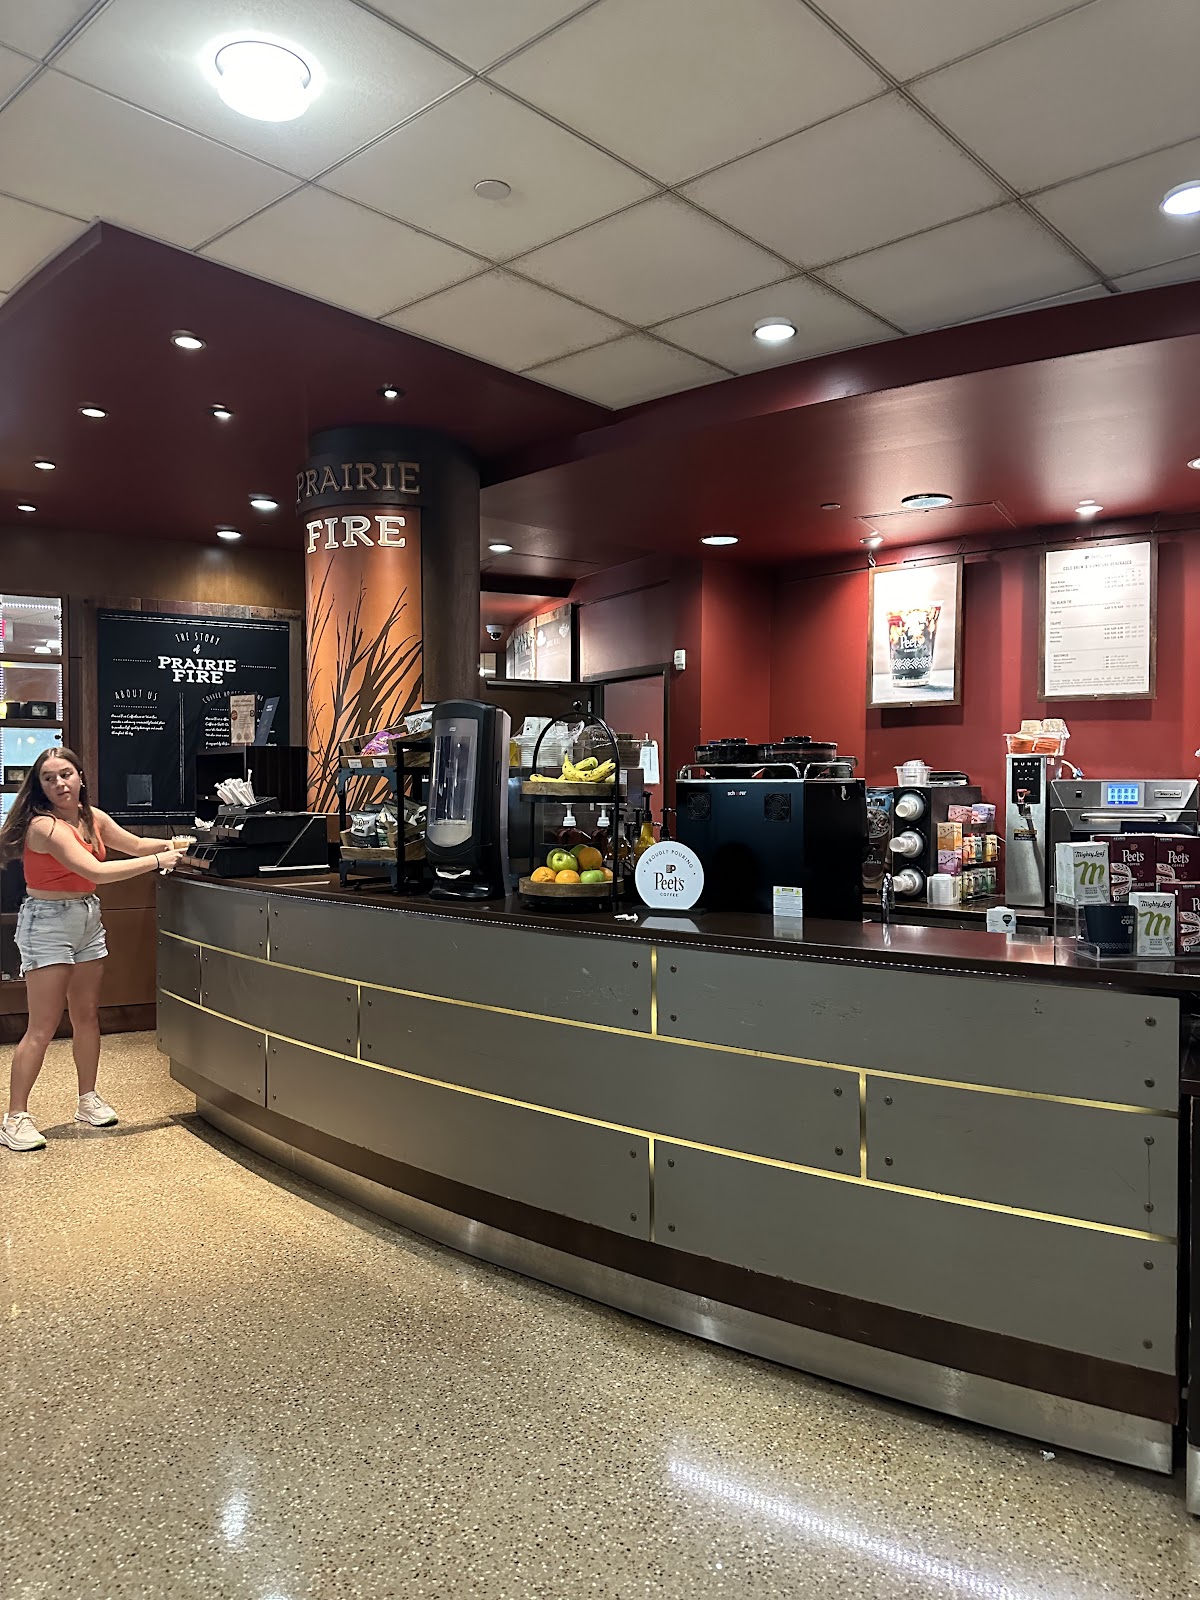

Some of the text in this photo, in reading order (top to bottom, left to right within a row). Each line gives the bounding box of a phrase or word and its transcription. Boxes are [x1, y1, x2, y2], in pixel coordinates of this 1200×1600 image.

[296, 461, 420, 504] PRAIRIE
[306, 515, 406, 554] FIRE
[175, 631, 221, 646] THE STORY
[157, 655, 237, 673] PRAIRIE
[172, 668, 223, 685] FIRE
[114, 689, 158, 701] ABOUT US
[645, 849, 694, 869] PROUDLY POURING
[1074, 850, 1094, 859] Mighty
[1121, 849, 1145, 863] Peet's
[1167, 850, 1190, 864] Peet's
[654, 872, 685, 892] Peet's
[1140, 900, 1173, 909] Mighty Leaf
